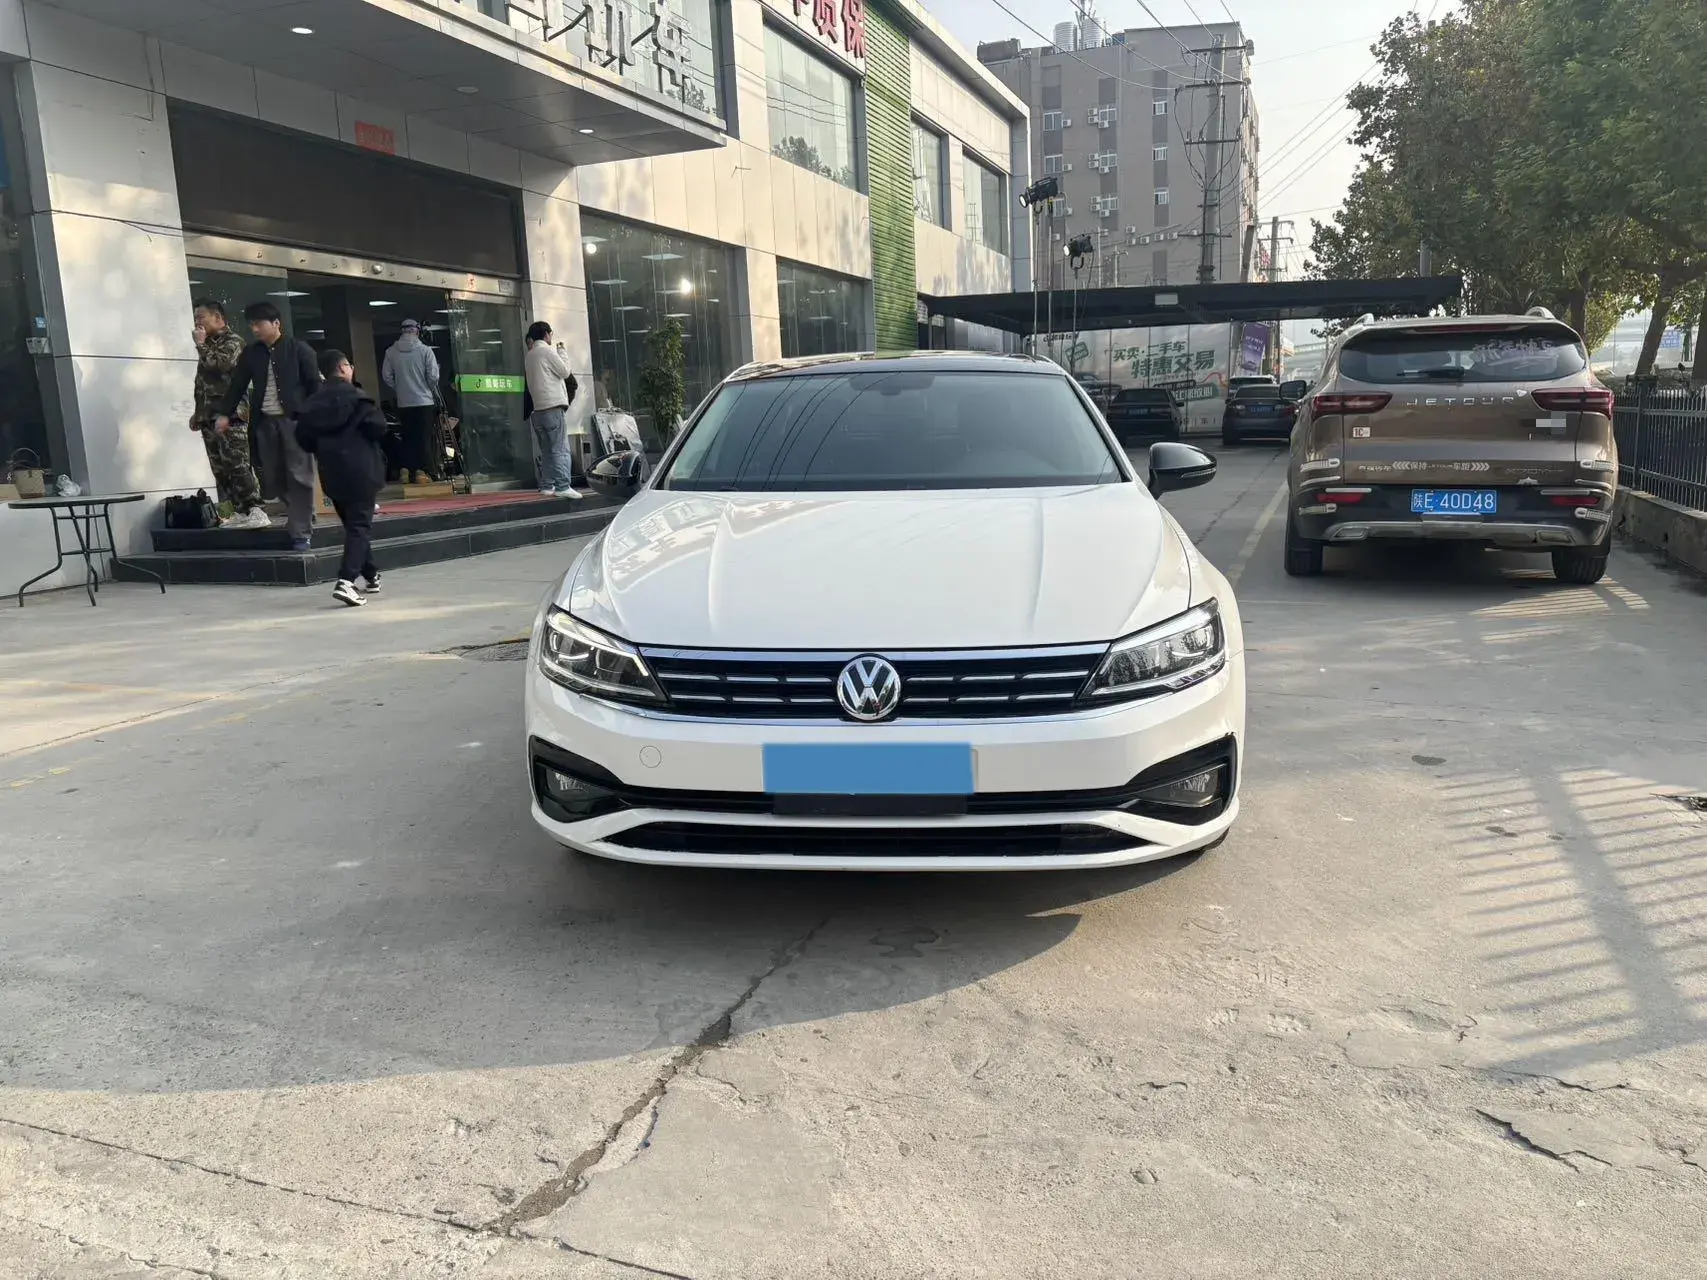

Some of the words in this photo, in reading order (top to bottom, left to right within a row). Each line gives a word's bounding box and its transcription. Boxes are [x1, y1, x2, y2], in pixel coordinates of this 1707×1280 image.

[793, 0, 866, 58] 质保
[1131, 350, 1216, 378] 特惠交易
